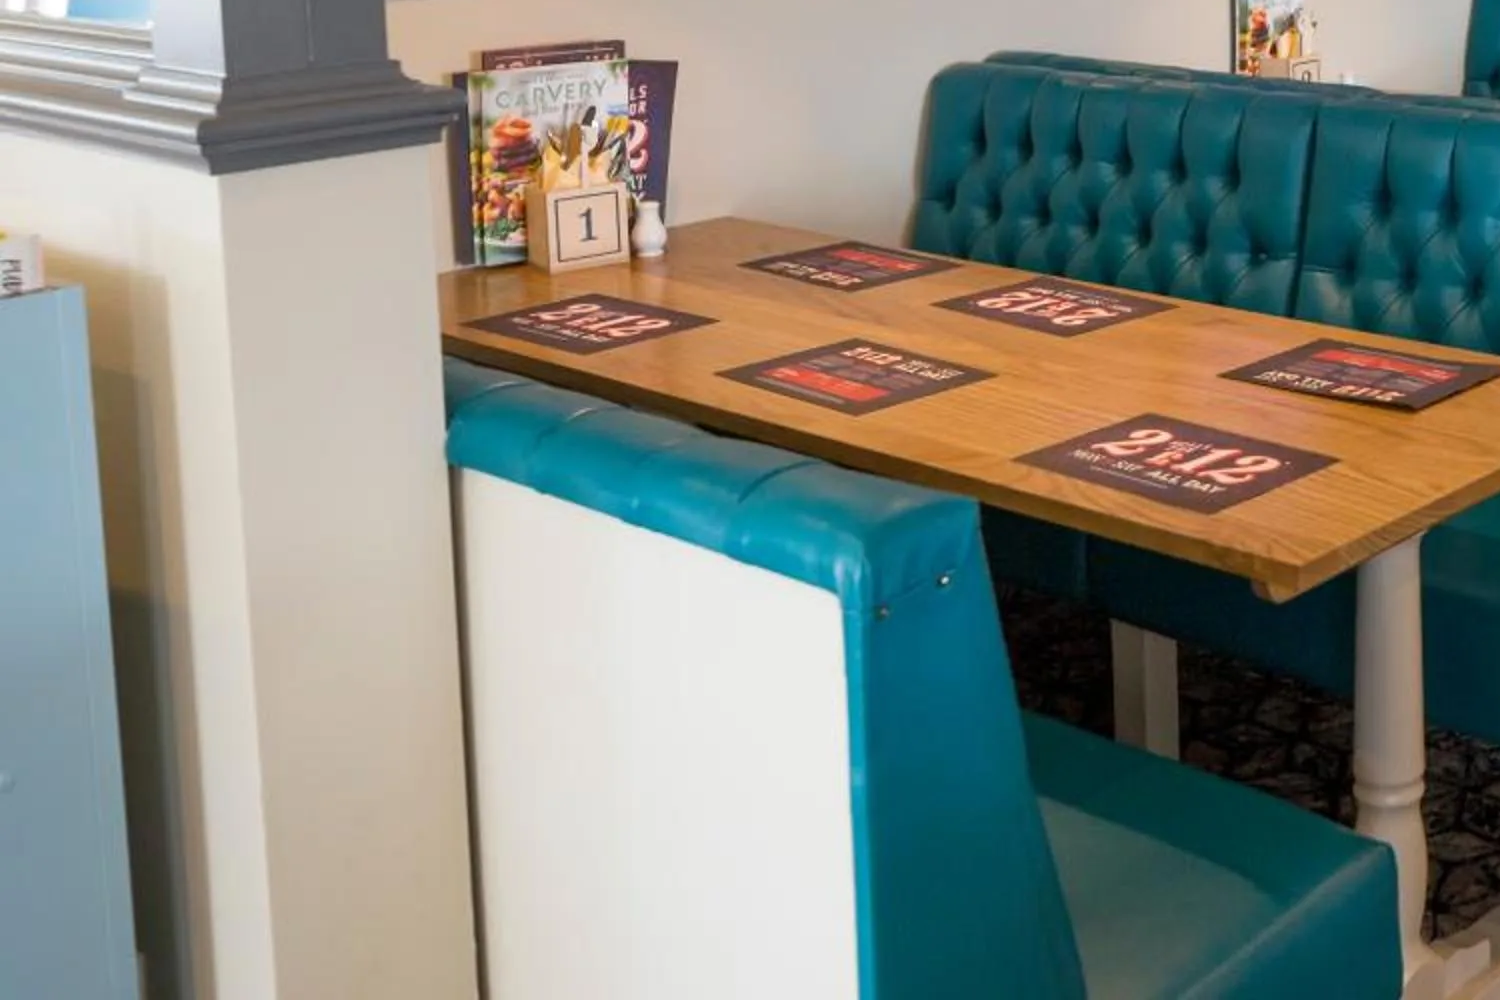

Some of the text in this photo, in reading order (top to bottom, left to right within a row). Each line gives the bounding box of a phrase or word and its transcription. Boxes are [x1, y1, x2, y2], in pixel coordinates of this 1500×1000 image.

[496, 78, 607, 110] CARVERY
[579, 207, 598, 242] 1
[1145, 470, 1183, 486] ALL
[1181, 479, 1227, 493] DAY
